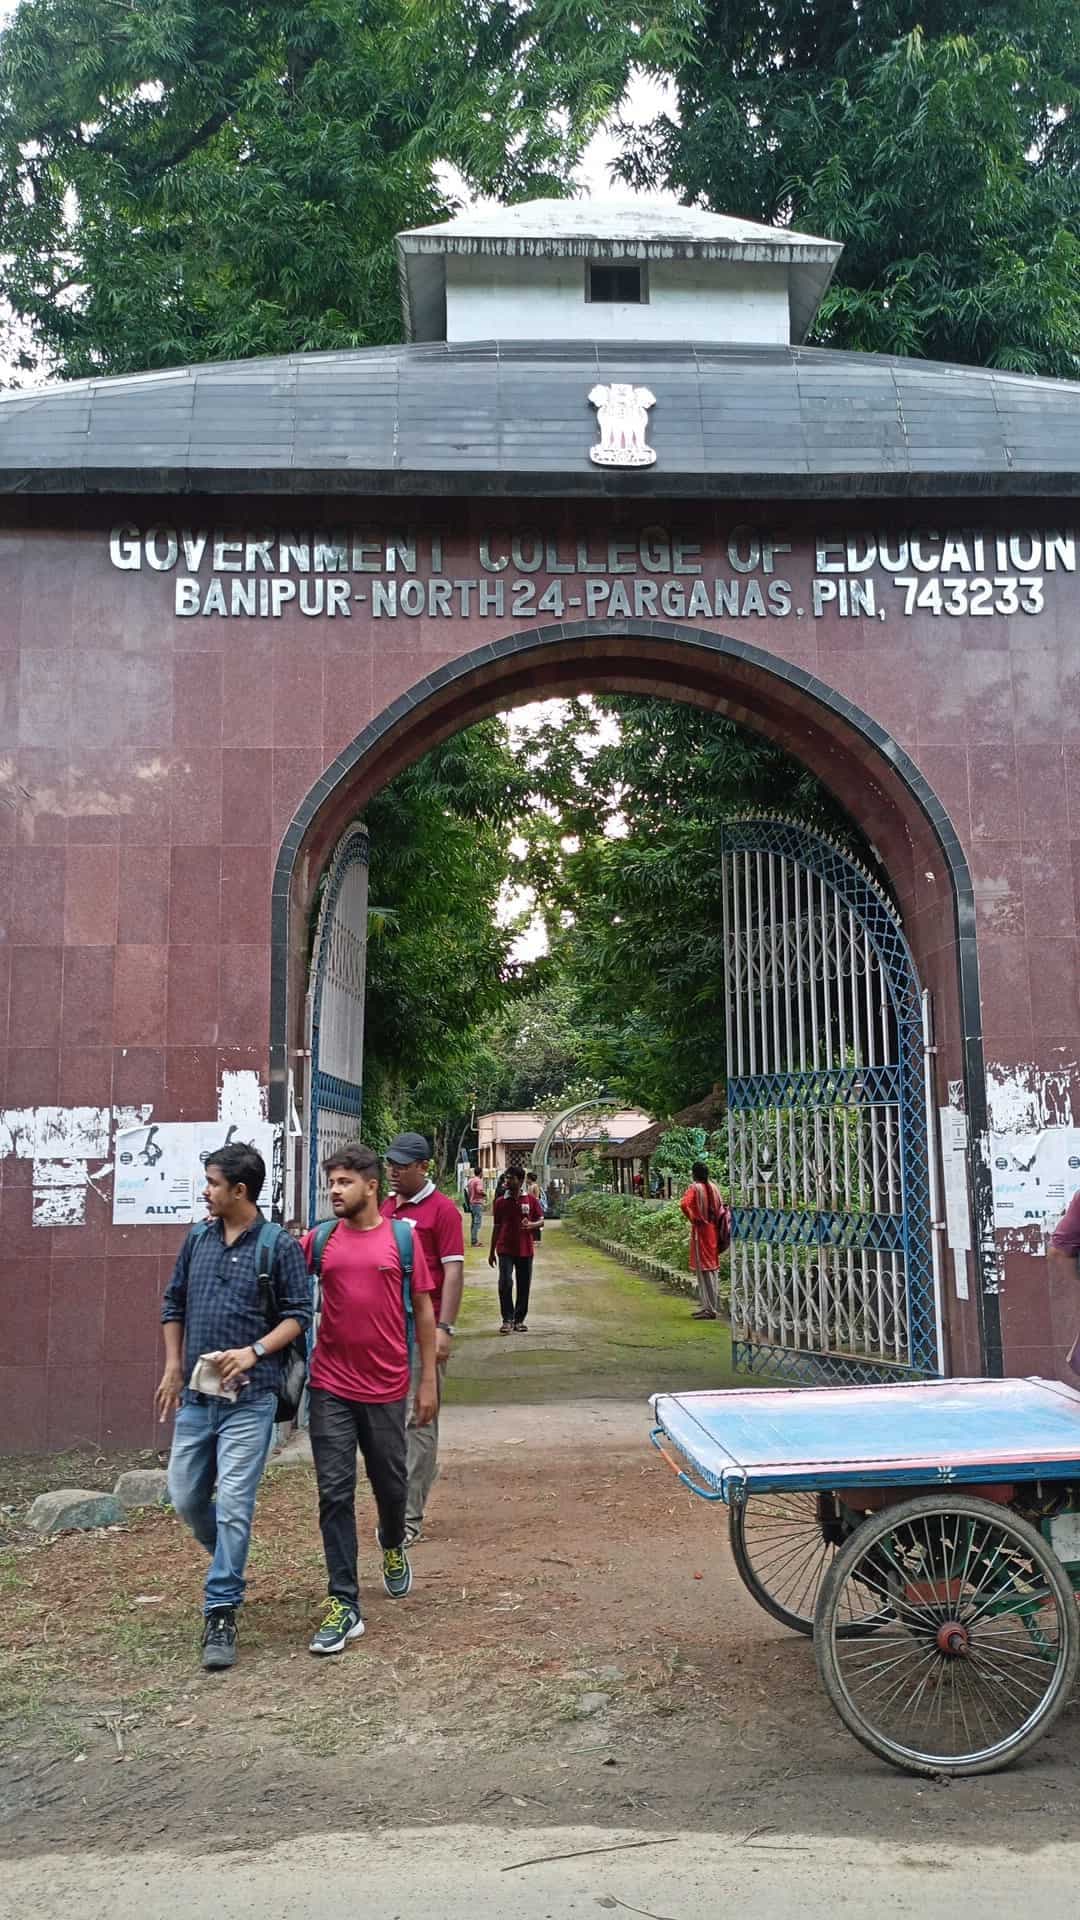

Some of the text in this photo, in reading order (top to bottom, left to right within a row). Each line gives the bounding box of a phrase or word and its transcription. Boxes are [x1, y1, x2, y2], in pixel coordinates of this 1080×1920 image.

[109, 523, 1077, 574] GOVERNMENT COLLEGE OF EDUCATION
[812, 578, 886, 621] PIN,
[894, 576, 1045, 617] 743233
